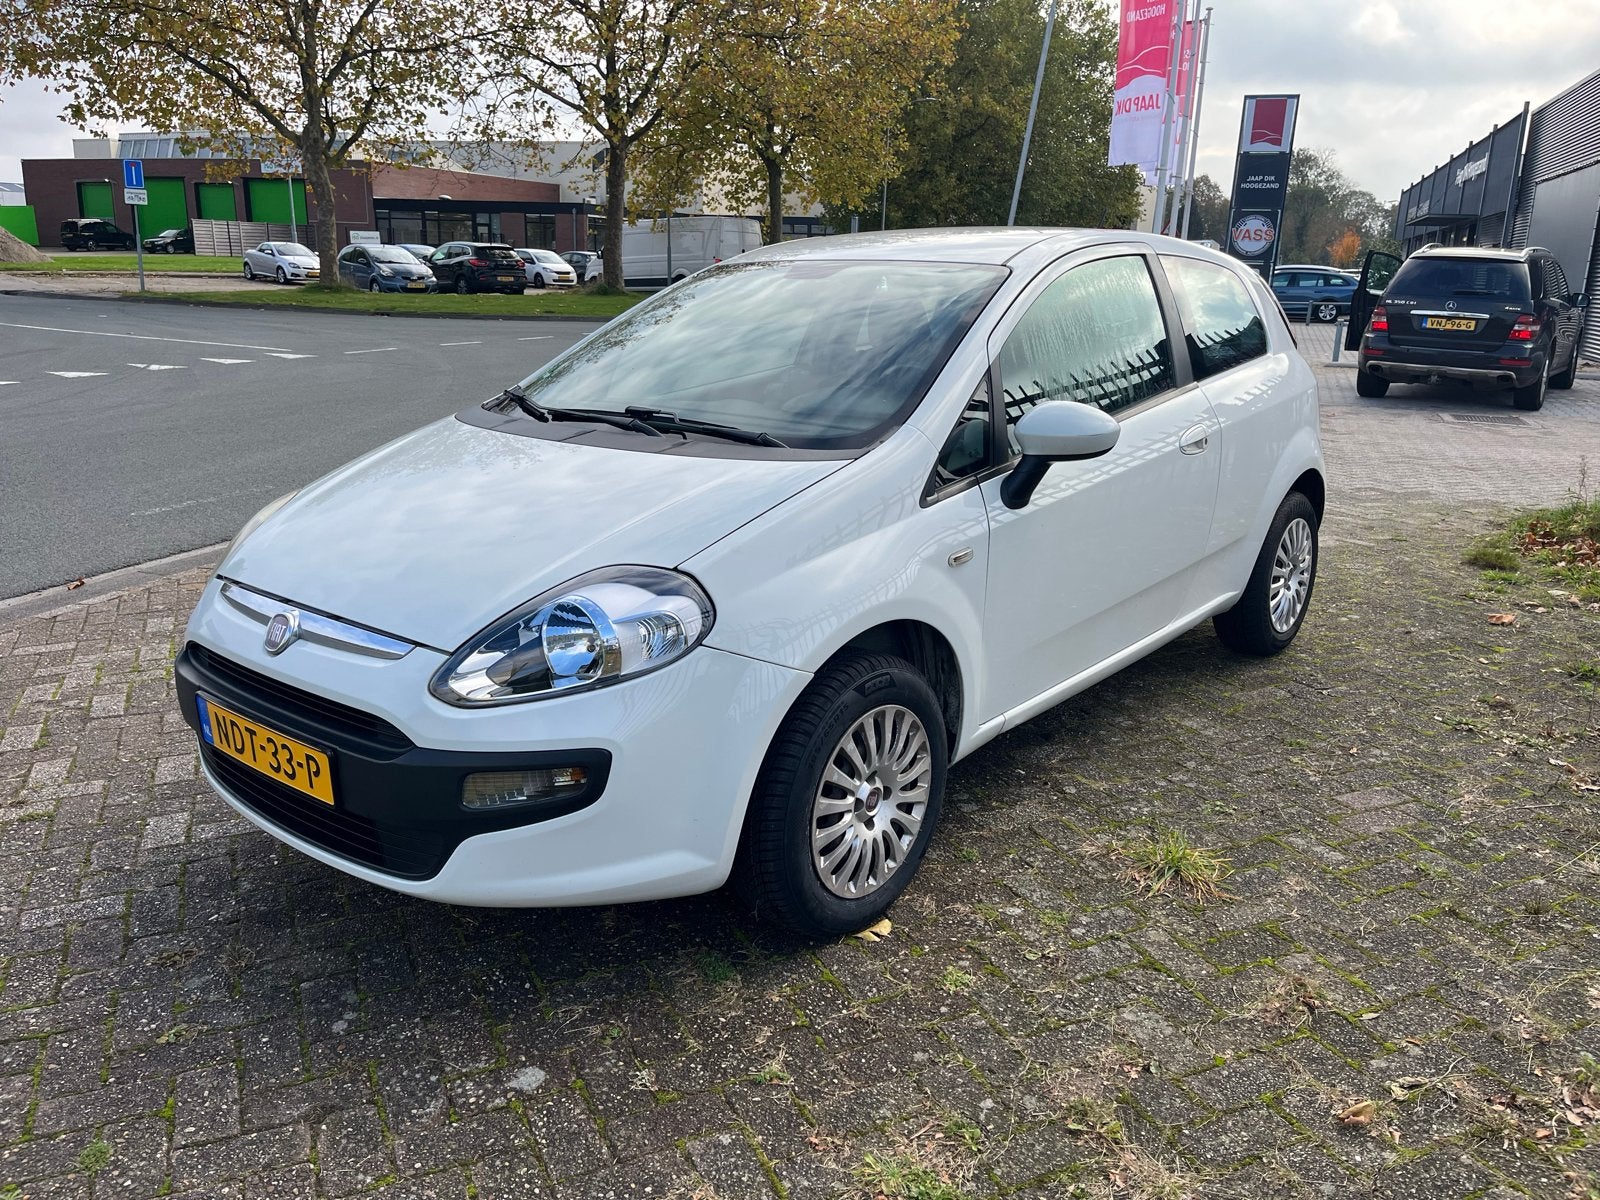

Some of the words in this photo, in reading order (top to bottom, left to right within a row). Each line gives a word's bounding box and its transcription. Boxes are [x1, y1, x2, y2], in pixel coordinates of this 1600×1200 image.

[1232, 227, 1275, 242] VASS
[1430, 318, 1472, 329] VNJ-96-G
[268, 622, 287, 643] FIAT
[214, 710, 321, 790] NDT-33-P
